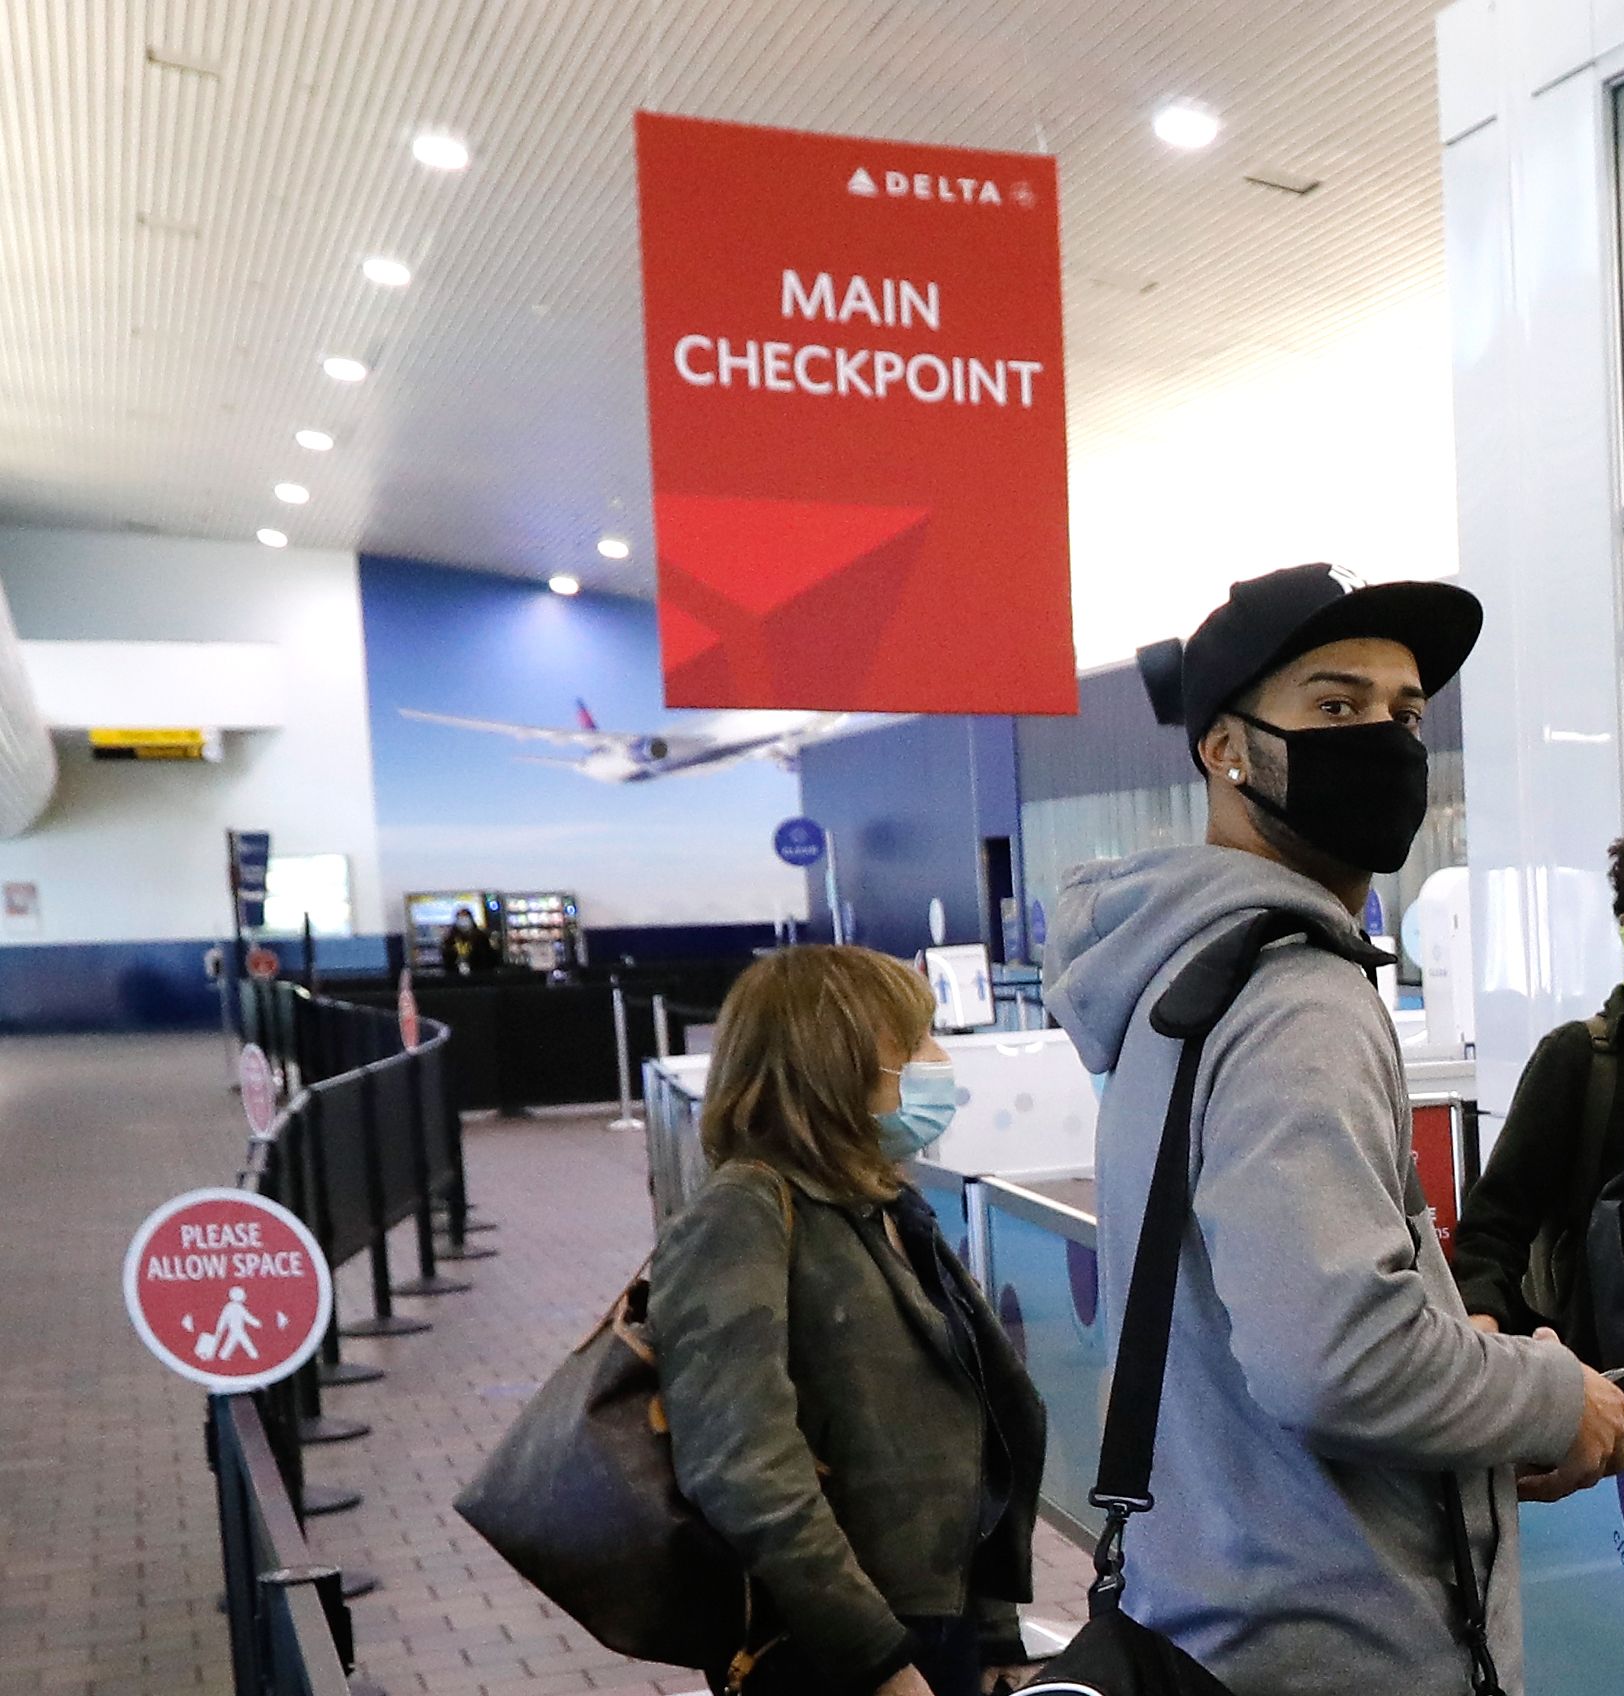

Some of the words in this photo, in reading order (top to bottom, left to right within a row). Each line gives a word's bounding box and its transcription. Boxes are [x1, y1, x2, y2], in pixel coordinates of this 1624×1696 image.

[885, 170, 1001, 206] DELTA
[781, 268, 941, 332] MAIN
[673, 333, 1043, 408] CHECKPOINT
[180, 1221, 263, 1249] PLEASE
[147, 1253, 228, 1281] ALLOW
[232, 1251, 304, 1279] SPACE
